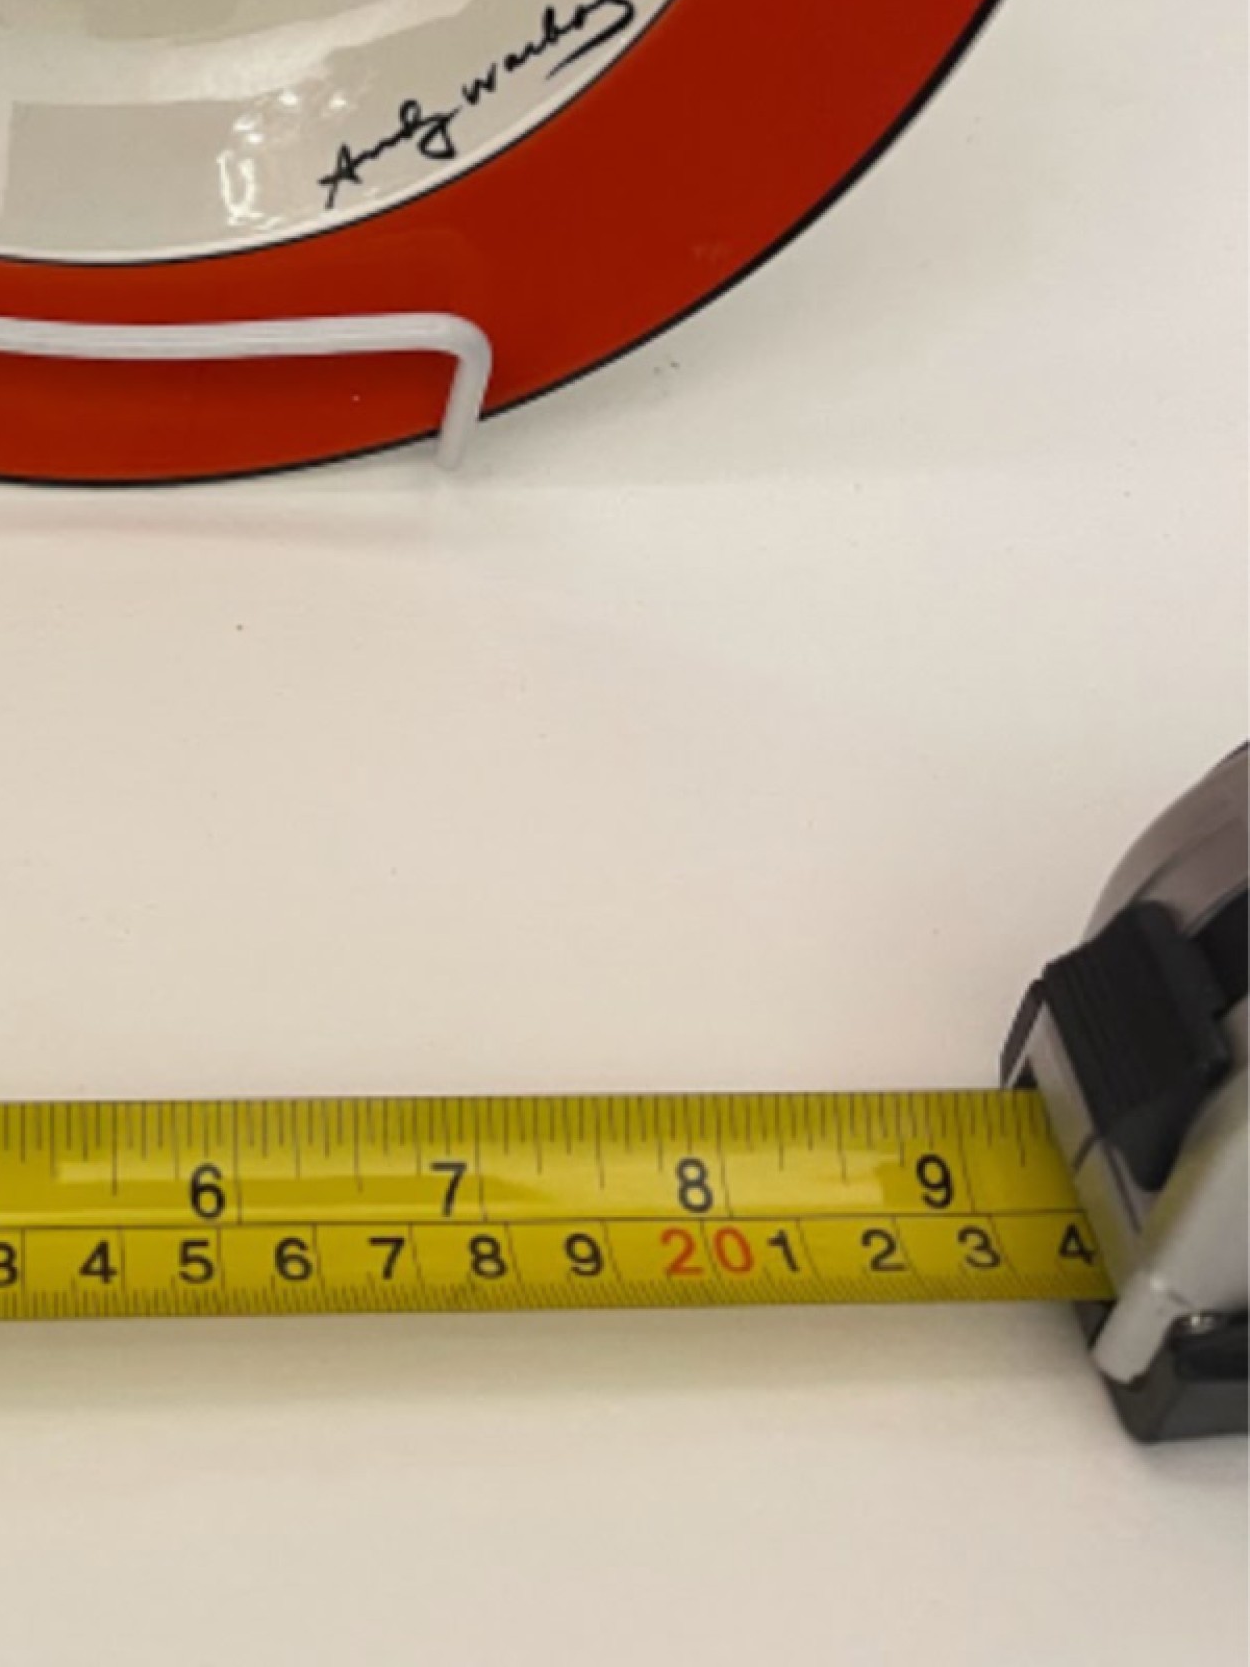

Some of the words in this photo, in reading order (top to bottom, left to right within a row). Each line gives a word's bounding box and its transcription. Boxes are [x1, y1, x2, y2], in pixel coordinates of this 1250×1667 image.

[189, 1163, 227, 1220] 6
[430, 1161, 468, 1218] 7
[676, 1157, 714, 1213] 8
[915, 1154, 954, 1209] 9
[79, 1241, 117, 1284] 4
[179, 1239, 215, 1284] 5
[274, 1237, 313, 1281] 6
[368, 1236, 405, 1280] 7
[468, 1235, 507, 1280] 8
[564, 1233, 604, 1277] 9
[659, 1227, 753, 1278] 20
[767, 1229, 800, 1272] 1
[861, 1229, 906, 1272] 2
[957, 1226, 1001, 1270] 3
[1058, 1223, 1094, 1266] 4
